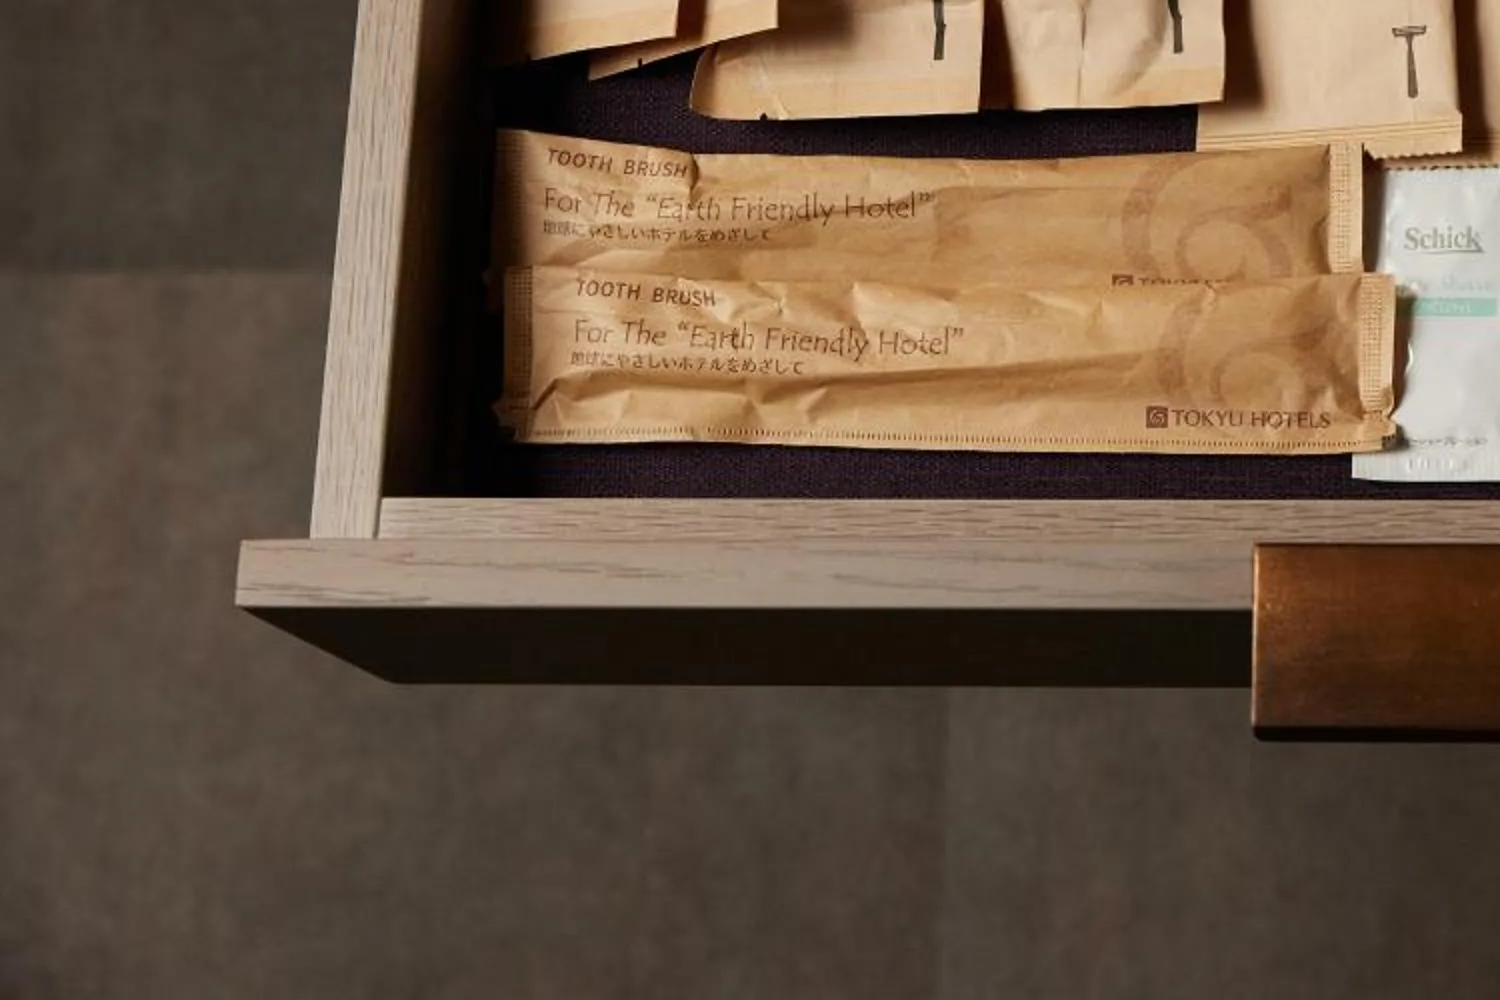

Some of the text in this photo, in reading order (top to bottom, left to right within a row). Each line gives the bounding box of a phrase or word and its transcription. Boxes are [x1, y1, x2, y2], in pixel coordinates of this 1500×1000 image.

[547, 149, 688, 179] TOOTH BRUSH
[543, 187, 581, 214] For
[592, 188, 634, 218] The
[730, 191, 835, 228] Friendly
[1403, 225, 1486, 253] Schick
[576, 279, 717, 308] TOOTH BRUSH
[574, 317, 615, 345] For
[621, 316, 668, 348] The
[765, 325, 871, 364] Friendly
[1171, 408, 1332, 430] TOKYU HOTELS
